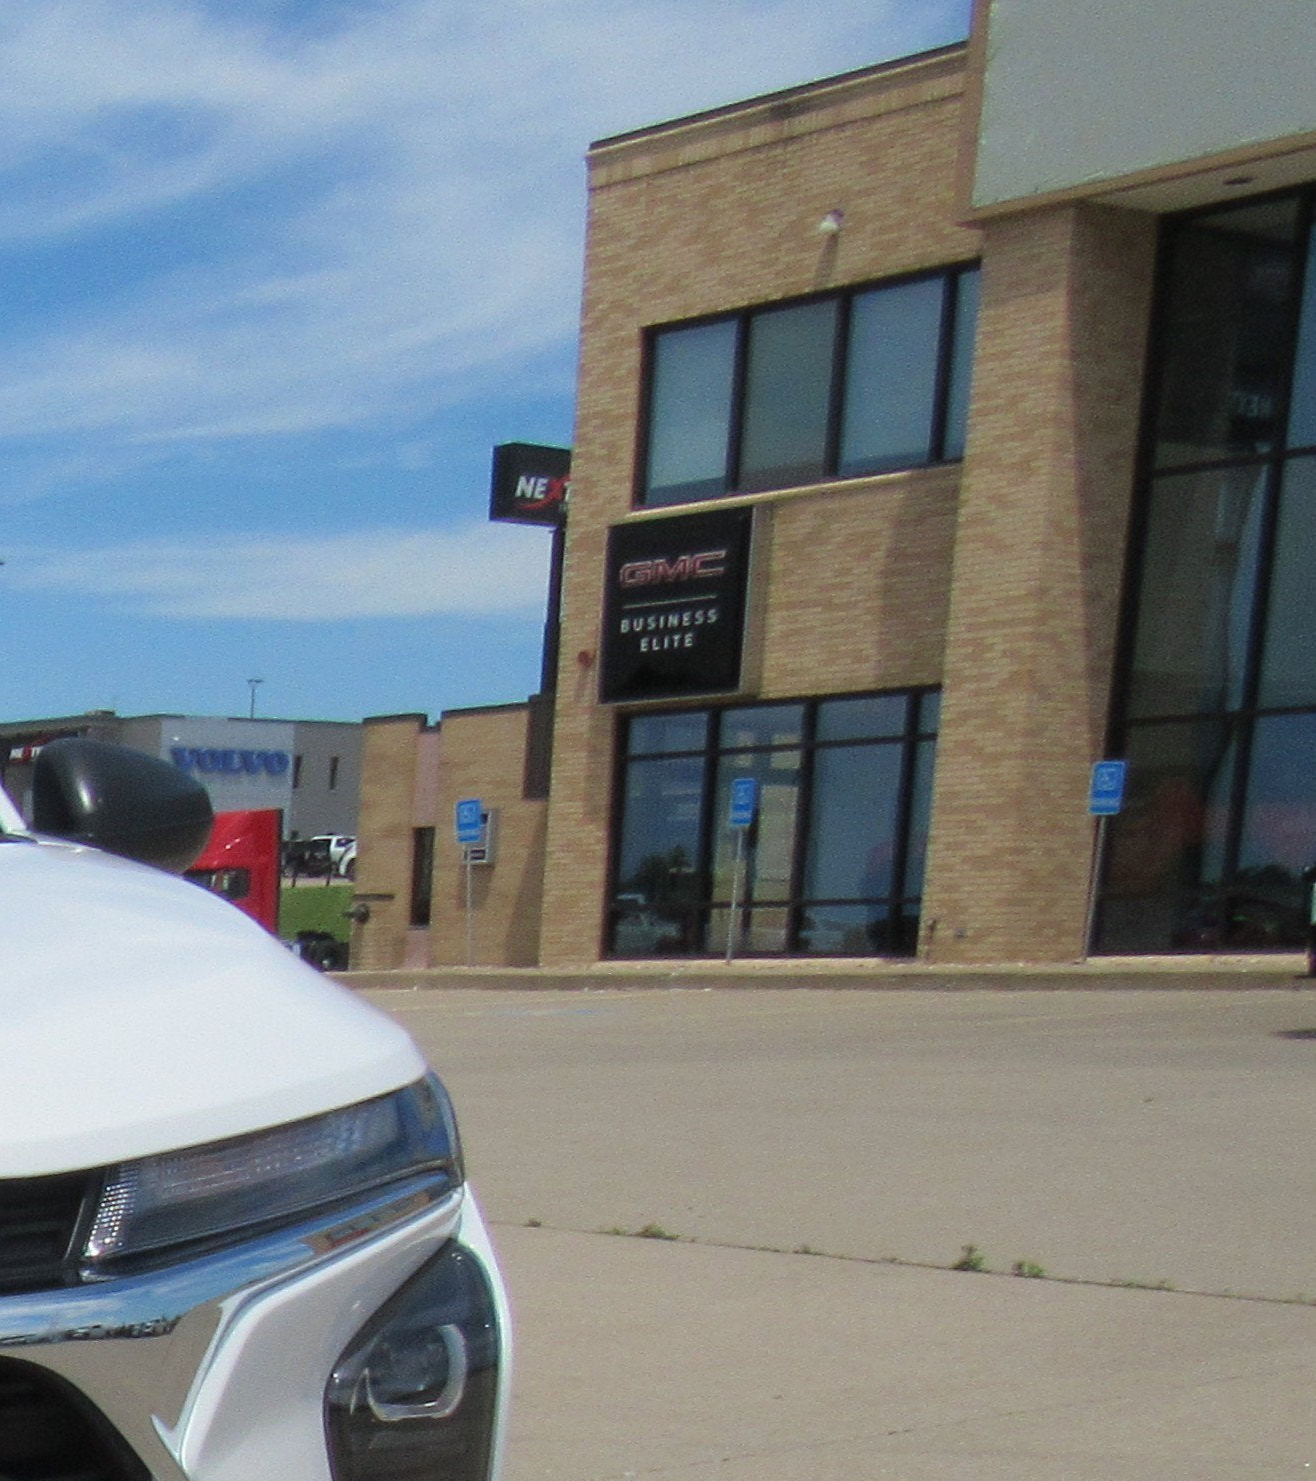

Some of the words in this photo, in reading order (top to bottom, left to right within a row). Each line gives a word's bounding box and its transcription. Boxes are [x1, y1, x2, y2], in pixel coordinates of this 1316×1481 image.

[620, 550, 726, 588] GMC
[621, 609, 717, 633] BUSINESS
[640, 634, 695, 652] ELITE
[170, 746, 290, 776] VOLVO
